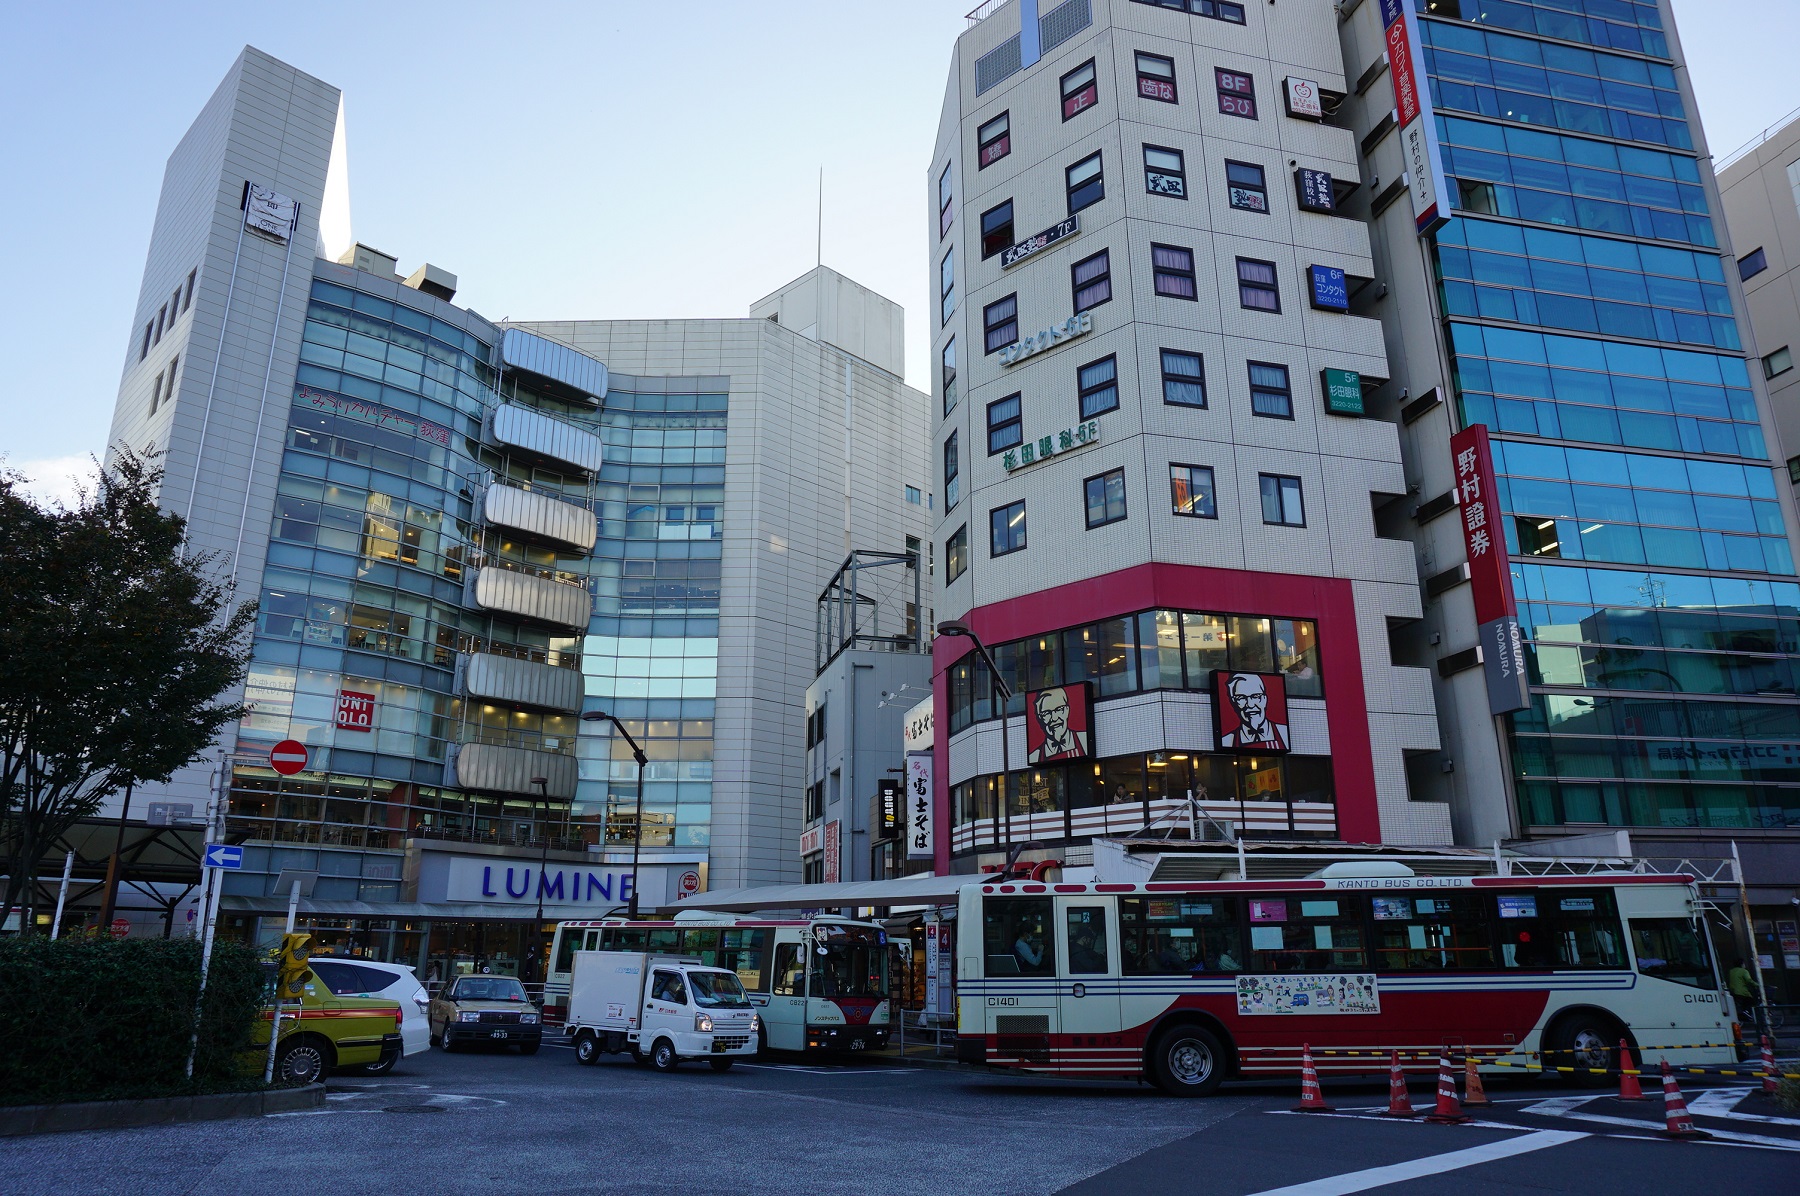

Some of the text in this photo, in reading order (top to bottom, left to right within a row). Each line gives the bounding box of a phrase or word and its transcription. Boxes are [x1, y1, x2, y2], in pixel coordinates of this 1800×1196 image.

[1141, 79, 1172, 100] 歯な
[1222, 74, 1246, 91] 8F
[1395, 41, 1415, 121] カワイ音楽教室
[1073, 91, 1088, 113] 正
[1224, 96, 1250, 115] らび
[988, 143, 1002, 162] 矯
[1150, 174, 1182, 193] 武田
[1315, 274, 1326, 283] 荻窪
[1330, 270, 1342, 280] 6F
[1317, 283, 1344, 296] コンタクト
[1318, 295, 1346, 304] 3220-2110
[1345, 372, 1356, 382] 5F
[1330, 384, 1360, 400] 杉田眼科
[1332, 400, 1362, 410] 3220-2122
[298, 387, 450, 445] よみうりカルチャー 荻窪
[1458, 446, 1490, 558] 野村證券
[1496, 623, 1510, 679] NOMURA
[1509, 621, 1524, 676] NOMURA
[340, 694, 368, 711] UNI
[338, 710, 368, 726] QLO
[884, 790, 895, 828] DOUTOR
[914, 777, 930, 849] 富士そば
[482, 866, 634, 902] LUMINE
[1338, 880, 1378, 888] KANTO
[1385, 879, 1410, 888] BUS
[942, 933, 948, 945] 4
[988, 997, 1019, 1006] C1401
[1684, 994, 1718, 1003] C1401
